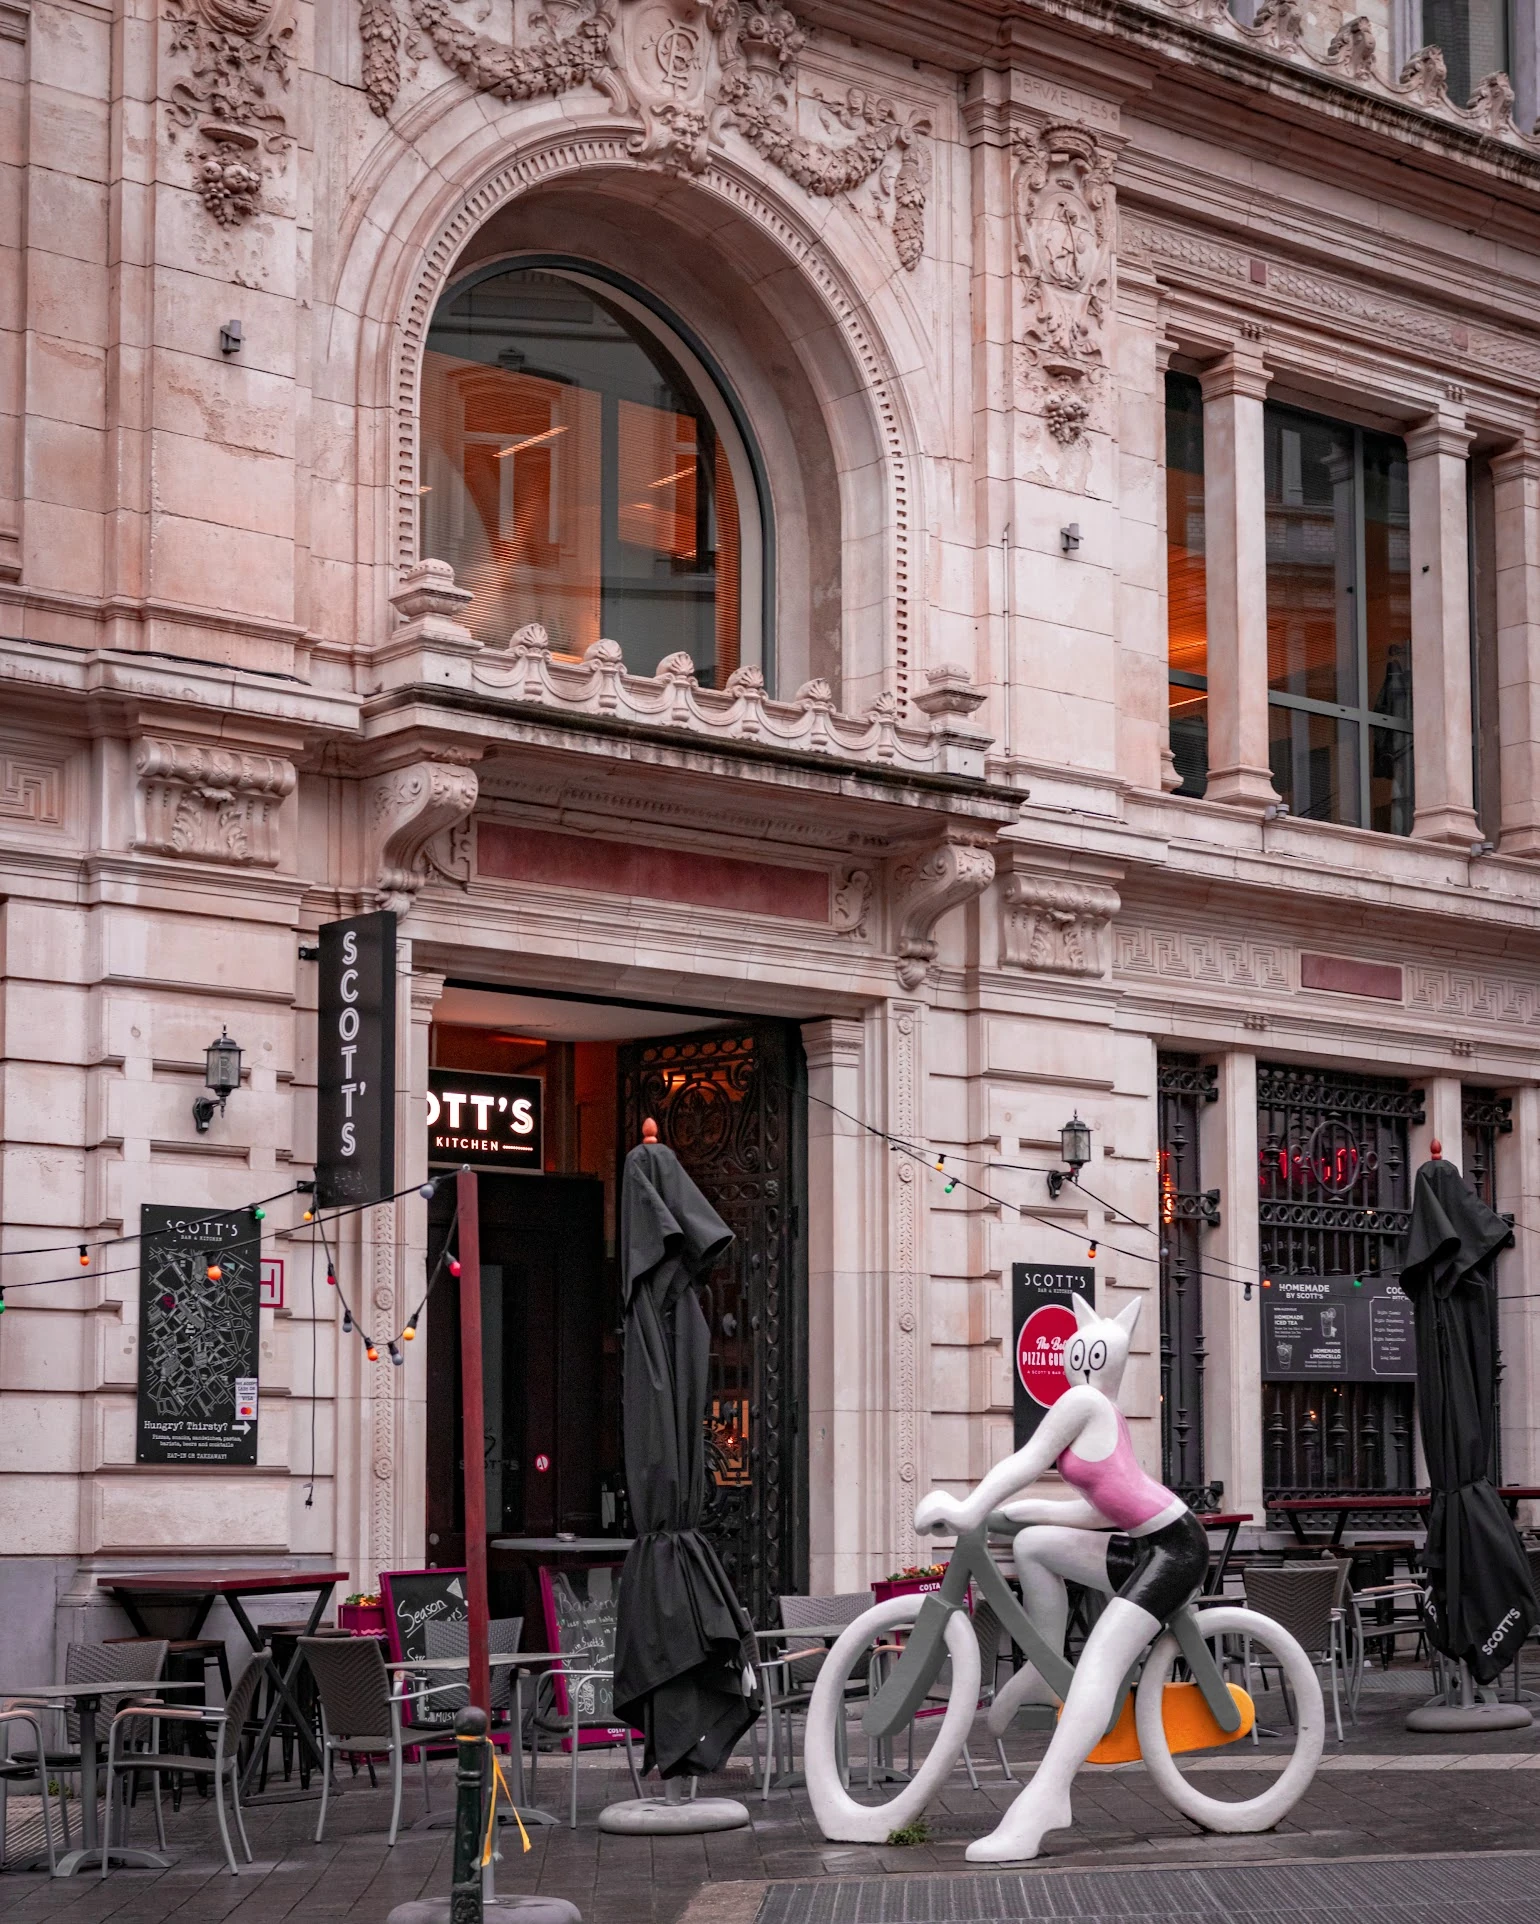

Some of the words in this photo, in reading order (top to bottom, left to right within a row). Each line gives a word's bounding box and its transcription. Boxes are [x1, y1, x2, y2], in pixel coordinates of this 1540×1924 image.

[338, 930, 367, 1157] SCOTT'S
[426, 1090, 534, 1134] OTT'S
[436, 1136, 499, 1151] KITCHEN
[166, 1220, 238, 1237] SCOTT'S
[1025, 1273, 1086, 1289] SCOTT'S
[1279, 1283, 1330, 1293] HOMEMADE
[1297, 1292, 1324, 1300] SCOTT'S
[1386, 1286, 1405, 1295] COC
[1036, 1336, 1050, 1351] The
[1022, 1351, 1046, 1366] PIZZA
[144, 1421, 184, 1432] Hungry?
[187, 1422, 228, 1433] Thirsty?
[919, 1582, 941, 1592] COSTA
[558, 1592, 590, 1614] Bar
[593, 1599, 618, 1611] serv
[397, 1599, 448, 1633] Season
[1481, 1607, 1521, 1655] SCOTT'S
